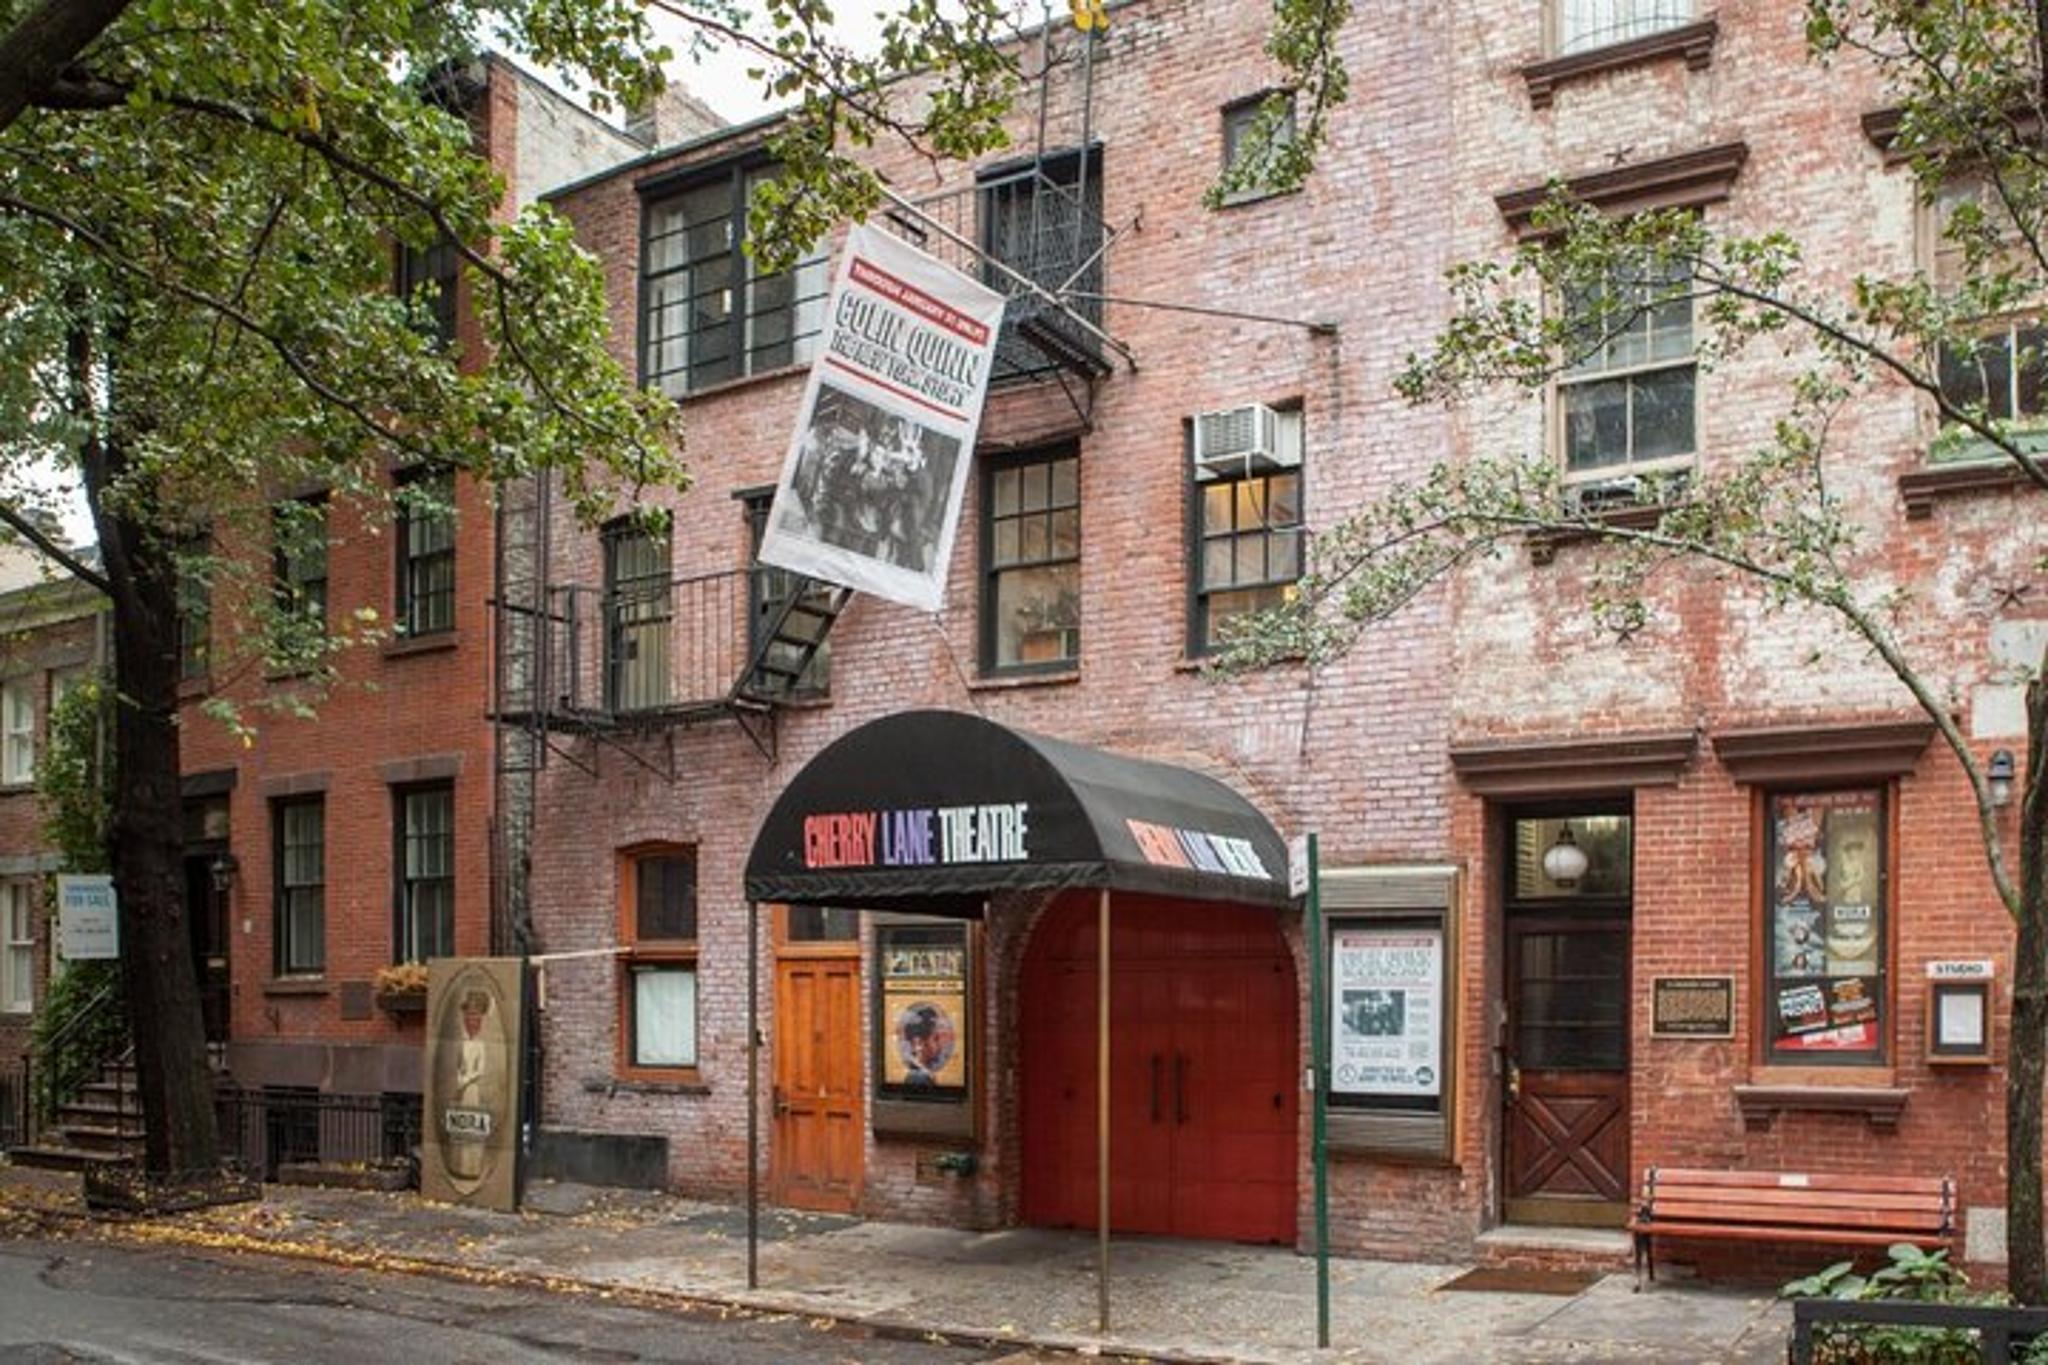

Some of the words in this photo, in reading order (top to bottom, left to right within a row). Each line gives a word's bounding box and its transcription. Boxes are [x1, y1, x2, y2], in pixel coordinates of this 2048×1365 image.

[804, 812, 877, 869] CHERRY
[880, 809, 936, 866] LANE
[938, 802, 1029, 864] THEATRE
[1934, 963, 1984, 975] STUDIO
[448, 1113, 488, 1132] NORA
